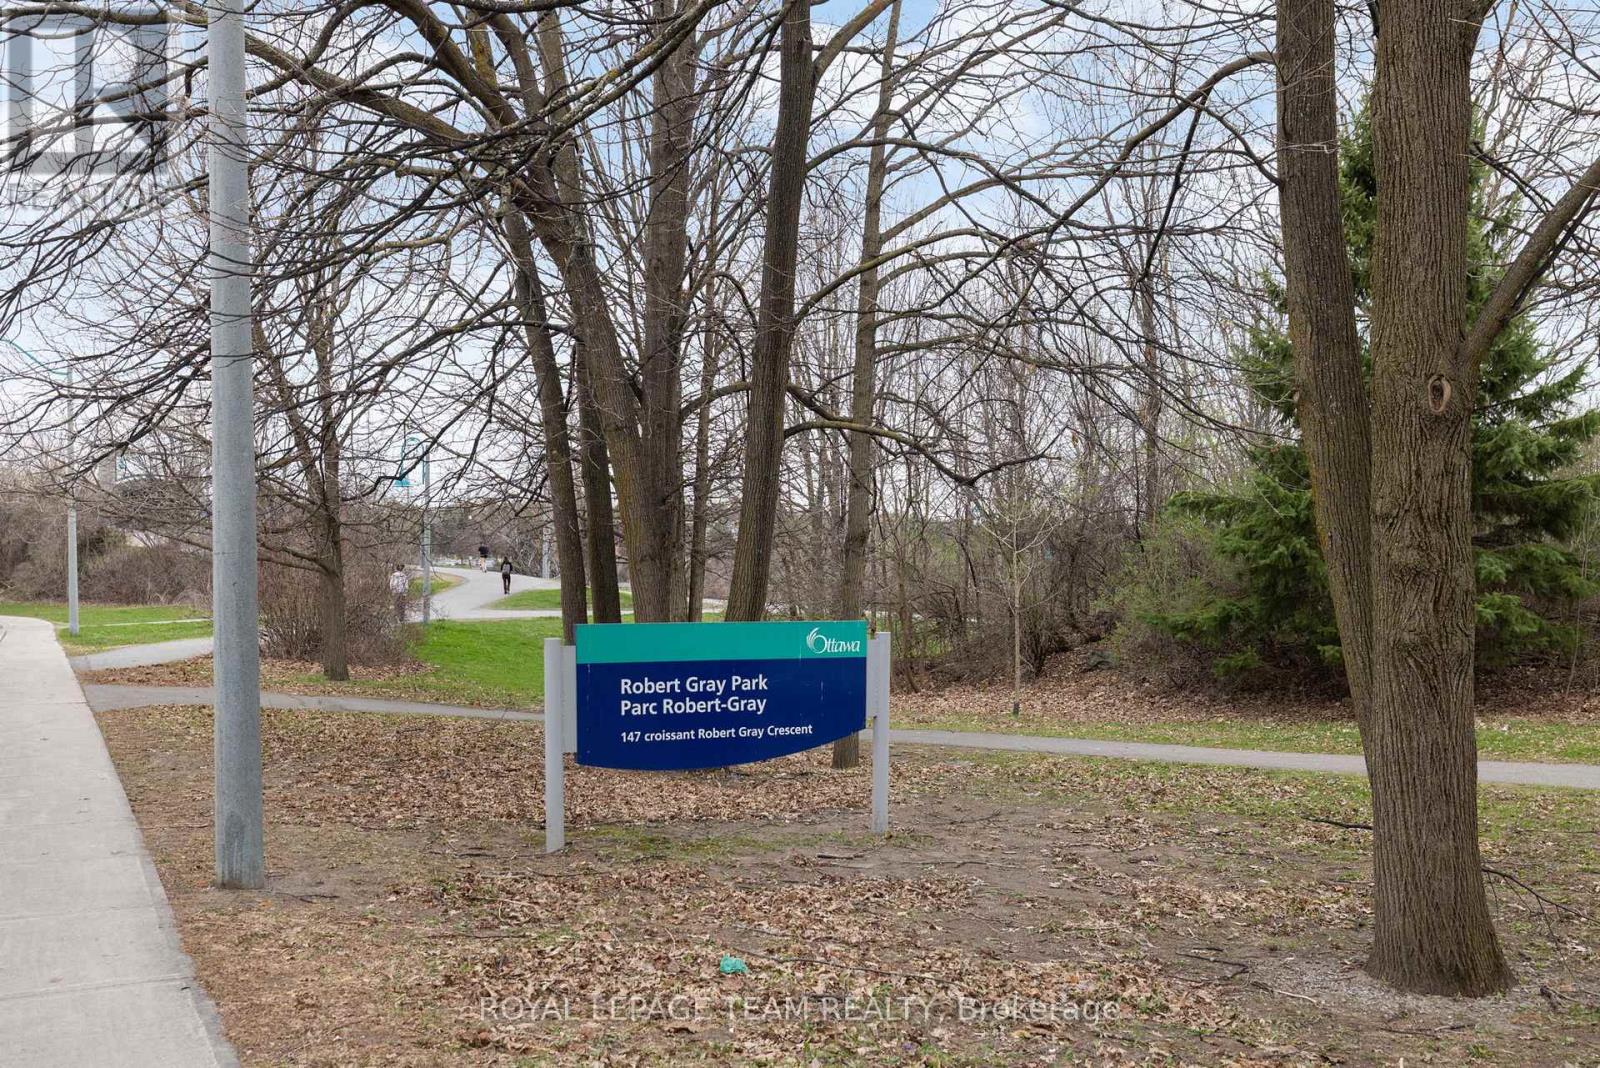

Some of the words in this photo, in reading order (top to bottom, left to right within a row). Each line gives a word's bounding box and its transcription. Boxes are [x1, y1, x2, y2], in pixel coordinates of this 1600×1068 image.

[806, 627, 861, 654] Ottawa
[620, 677, 681, 694] Robert
[685, 676, 727, 695] Gray
[731, 674, 768, 691] Park
[620, 700, 657, 716] Parc
[662, 696, 767, 715] Robert-Gray
[620, 731, 641, 742] 147
[644, 729, 695, 741] croissant
[698, 727, 736, 739] Robert
[738, 726, 764, 739] Gray
[767, 724, 813, 736] Crescent
